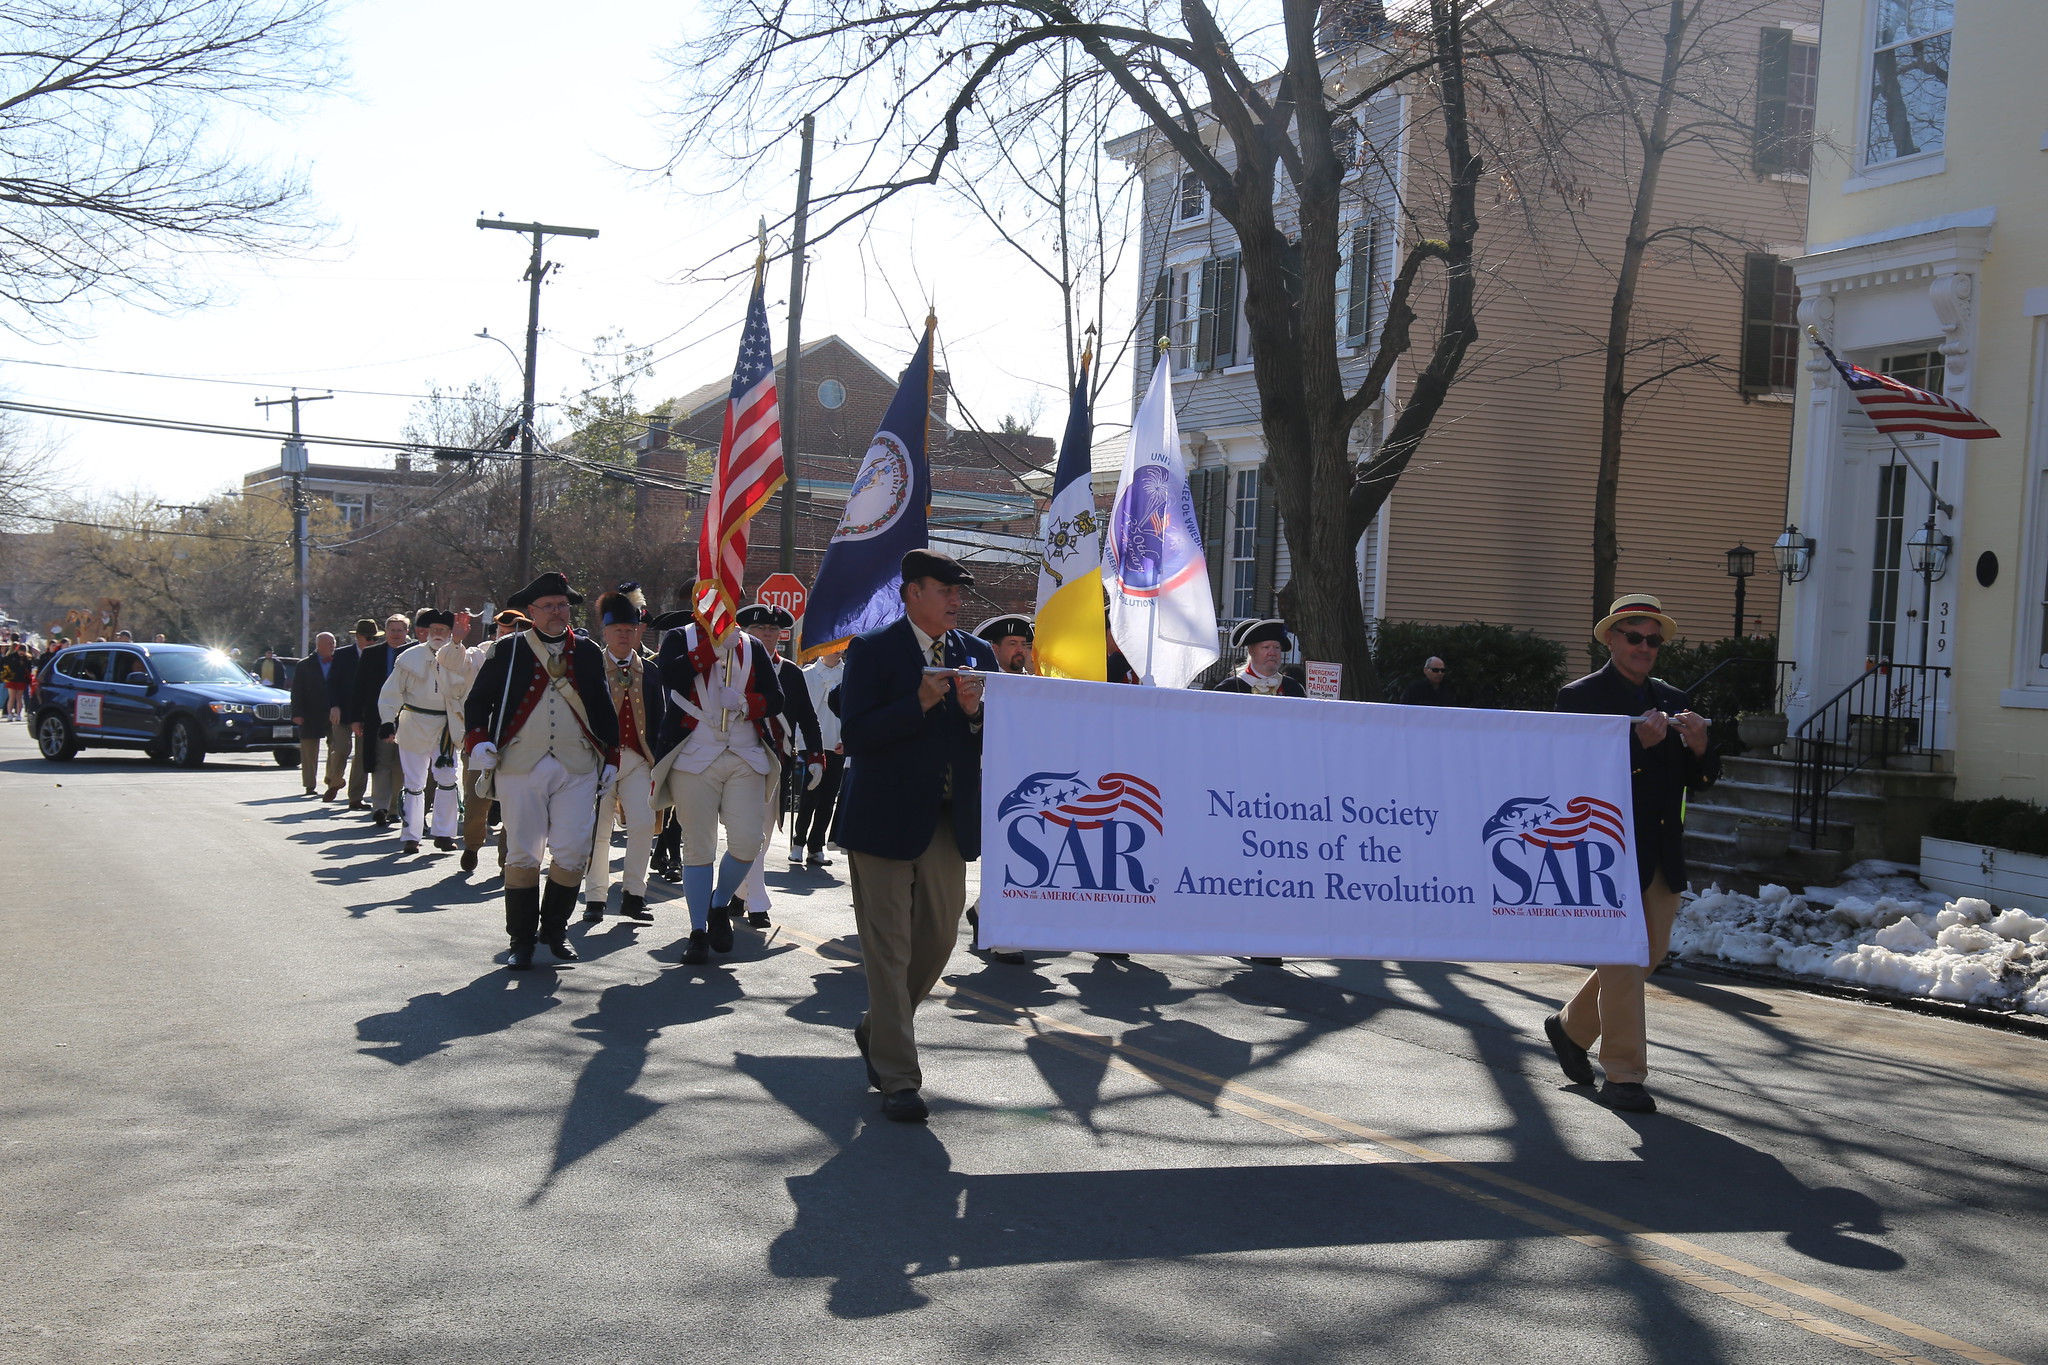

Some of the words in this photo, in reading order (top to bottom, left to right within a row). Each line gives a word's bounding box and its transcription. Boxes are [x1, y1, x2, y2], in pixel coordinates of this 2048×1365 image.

[884, 451, 899, 496] VIRGINIA
[761, 591, 803, 611] STOP
[1938, 602, 1949, 652] 319
[1309, 669, 1338, 677] EMERGENCY
[1309, 683, 1337, 692] PARKING
[1207, 789, 1333, 823] National
[1342, 796, 1439, 835] Society
[1004, 814, 1154, 894] SAR
[1242, 830, 1308, 860] Sons
[1318, 834, 1347, 861] of
[1359, 836, 1402, 863] the
[1174, 866, 1315, 899] American
[1325, 872, 1475, 903] Revolution
[1492, 837, 1624, 908] SAR
[1002, 889, 1028, 898] SONS
[1040, 890, 1092, 902] AMERICAN
[1094, 893, 1156, 904] REVOLUTION
[1492, 907, 1516, 915] SONS
[1526, 907, 1572, 917] AMERICAN
[1574, 909, 1627, 918] REVOLUTION
